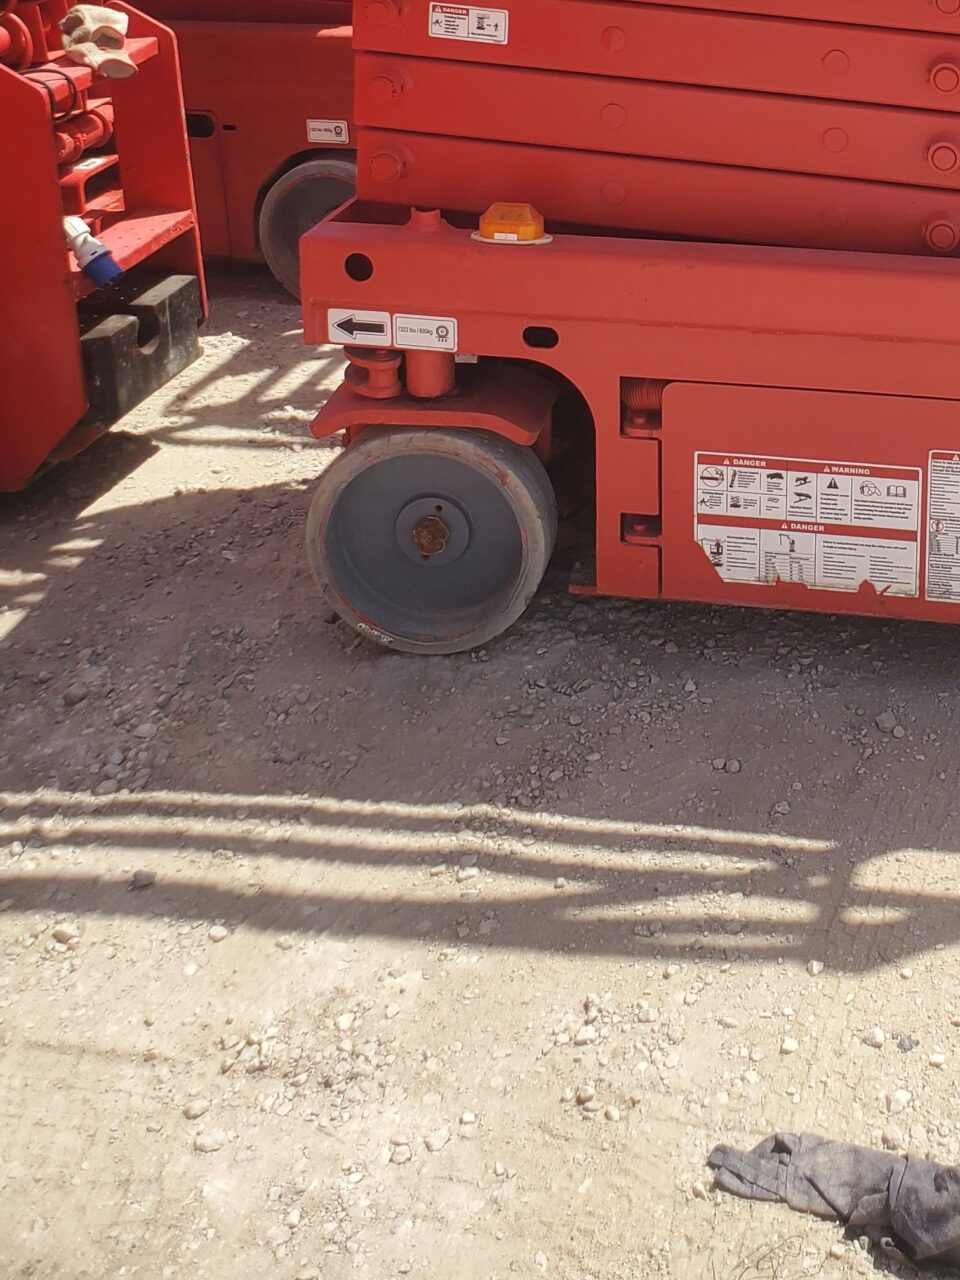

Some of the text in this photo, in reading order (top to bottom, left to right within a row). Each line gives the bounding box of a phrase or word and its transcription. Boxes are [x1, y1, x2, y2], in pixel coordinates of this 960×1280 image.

[733, 459, 767, 467] DANGER
[831, 466, 870, 475] WARNING
[790, 523, 825, 532] DANGER
